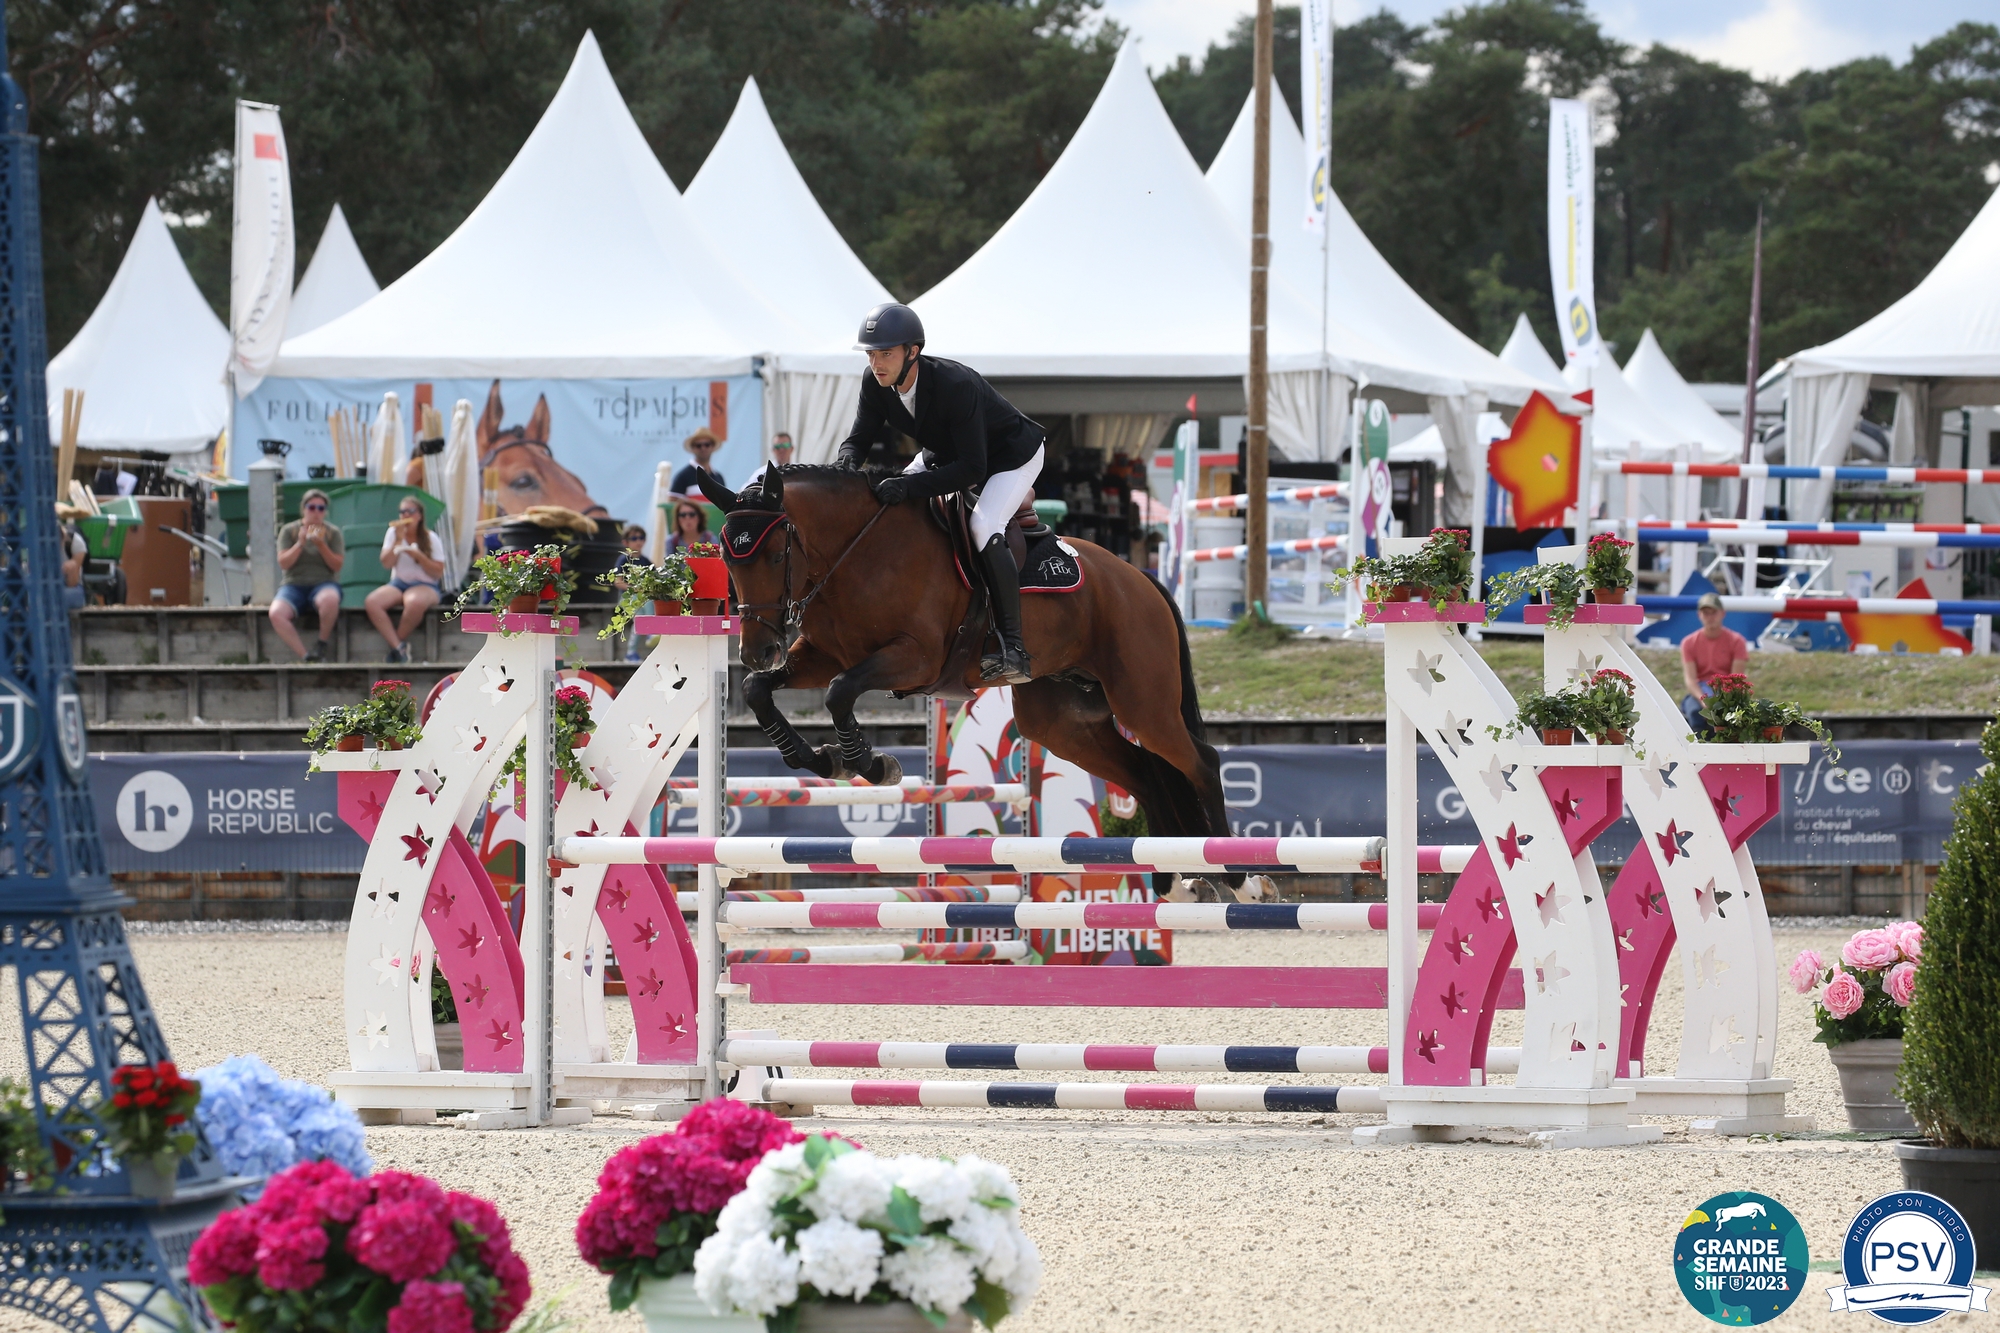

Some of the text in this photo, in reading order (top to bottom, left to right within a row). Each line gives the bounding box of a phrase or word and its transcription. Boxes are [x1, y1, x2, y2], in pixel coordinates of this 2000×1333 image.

[1793, 755, 1873, 806] ifce
[207, 788, 296, 811] HORSE
[208, 812, 334, 835] REPUBLIC
[1794, 805, 1881, 820] institut français
[1794, 819, 1852, 831] du cheval
[1794, 833, 1807, 845] et
[1808, 832, 1824, 845] de
[1054, 929, 1163, 954] LIBERTE
